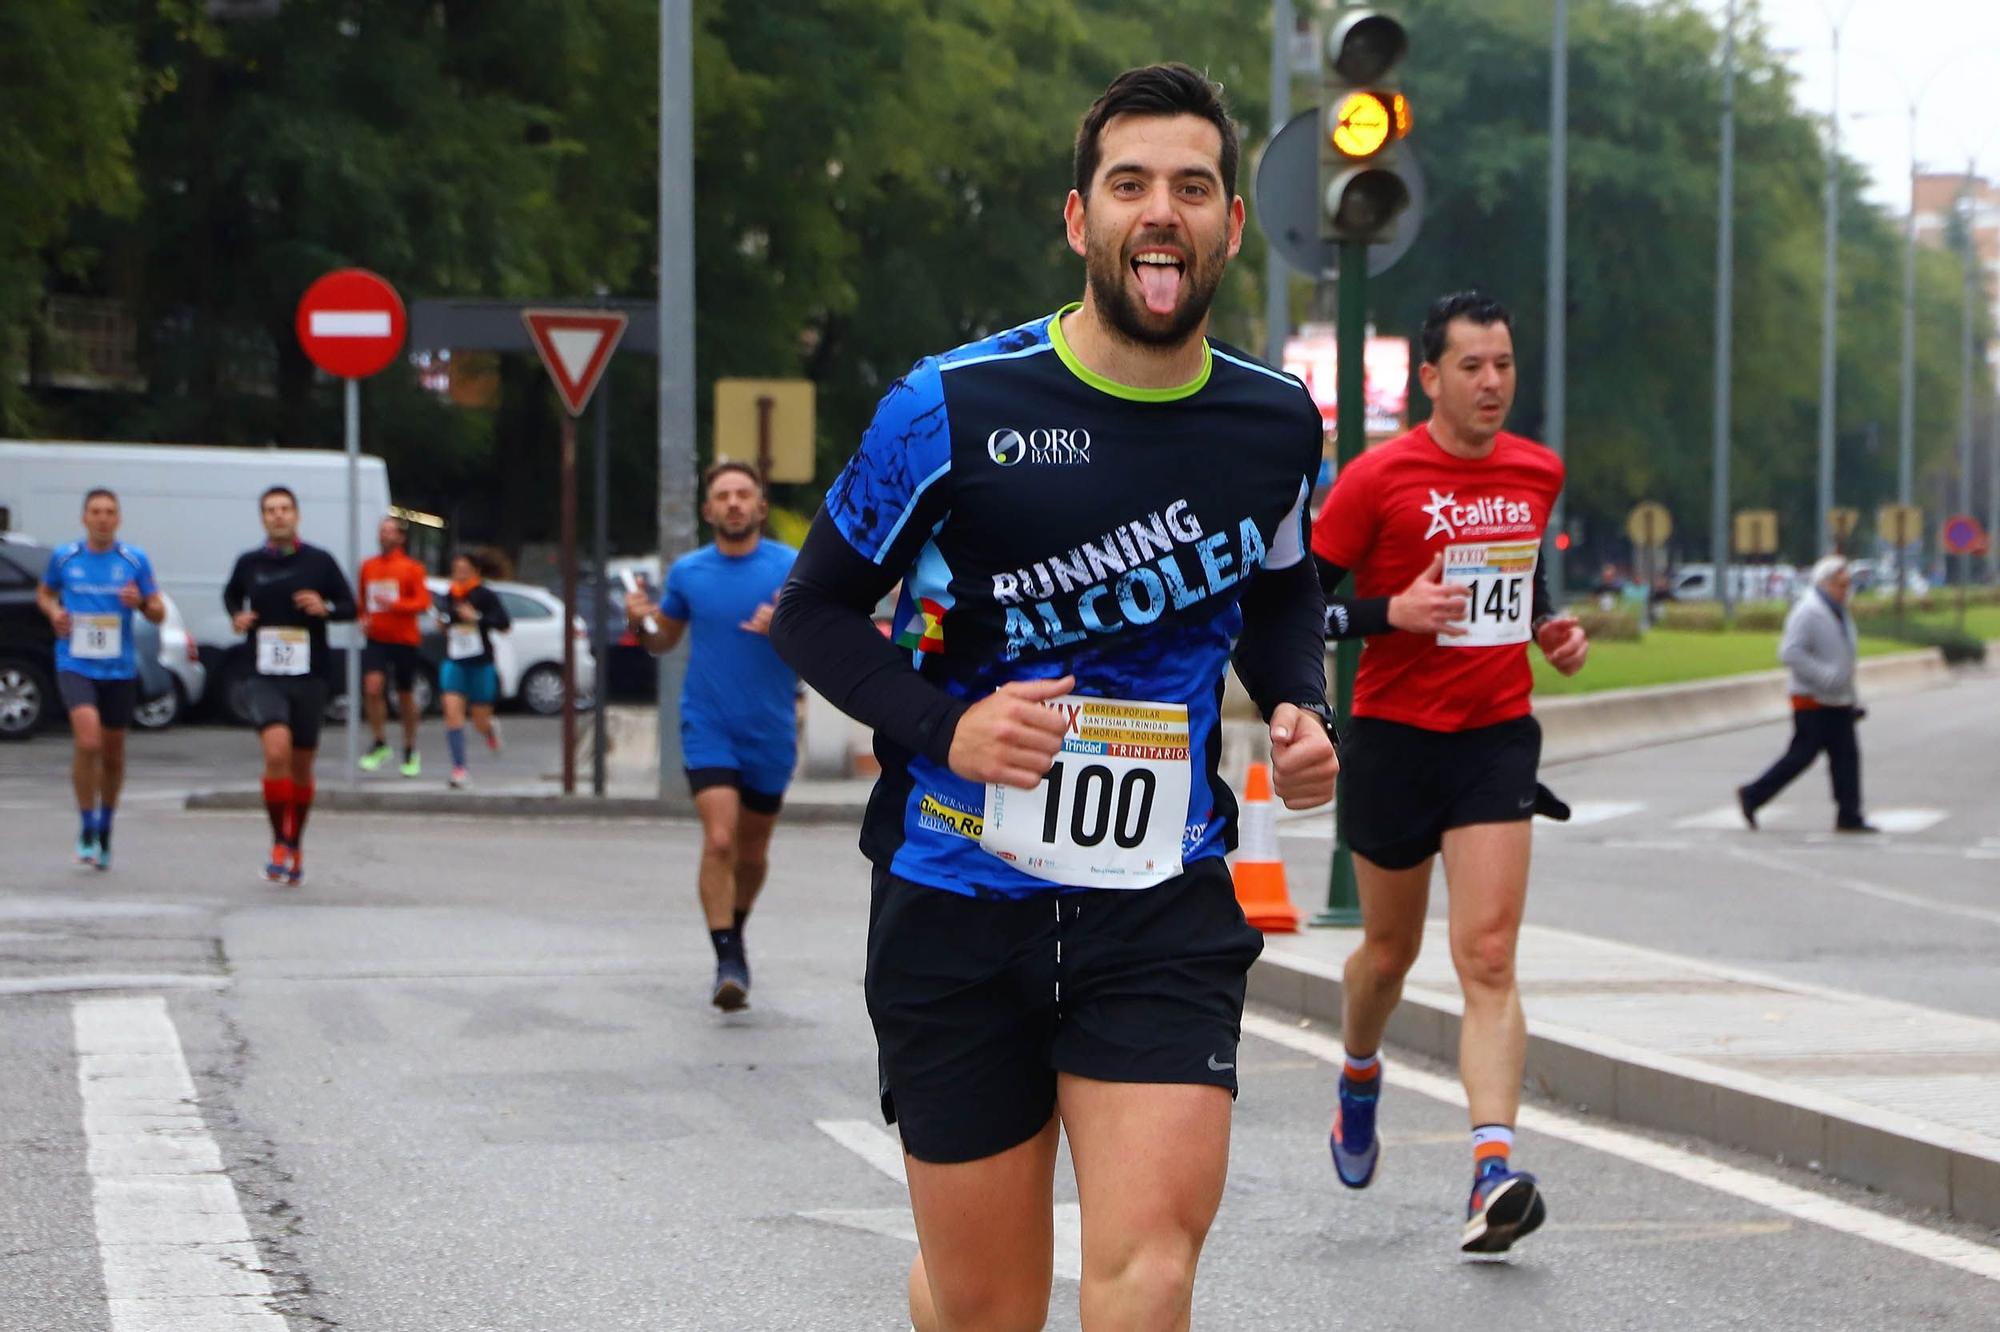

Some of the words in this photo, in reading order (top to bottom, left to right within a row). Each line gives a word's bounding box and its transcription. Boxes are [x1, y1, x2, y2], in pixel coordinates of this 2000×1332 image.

[1029, 428, 1091, 452] ORO
[1451, 495, 1532, 527] califas
[992, 498, 1204, 605] RUNNING
[1005, 516, 1266, 661] ALCOLEA
[1468, 578, 1523, 624] 145
[1083, 703, 1122, 717] CARRERA
[1124, 706, 1160, 719] POPULAR
[1130, 719, 1169, 731] TRINIDAD
[1081, 727, 1122, 739] MEMORIAL
[1065, 740, 1101, 754] Trinidad
[1111, 744, 1190, 760] TRINITARIOS
[1041, 761, 1157, 849] 100
